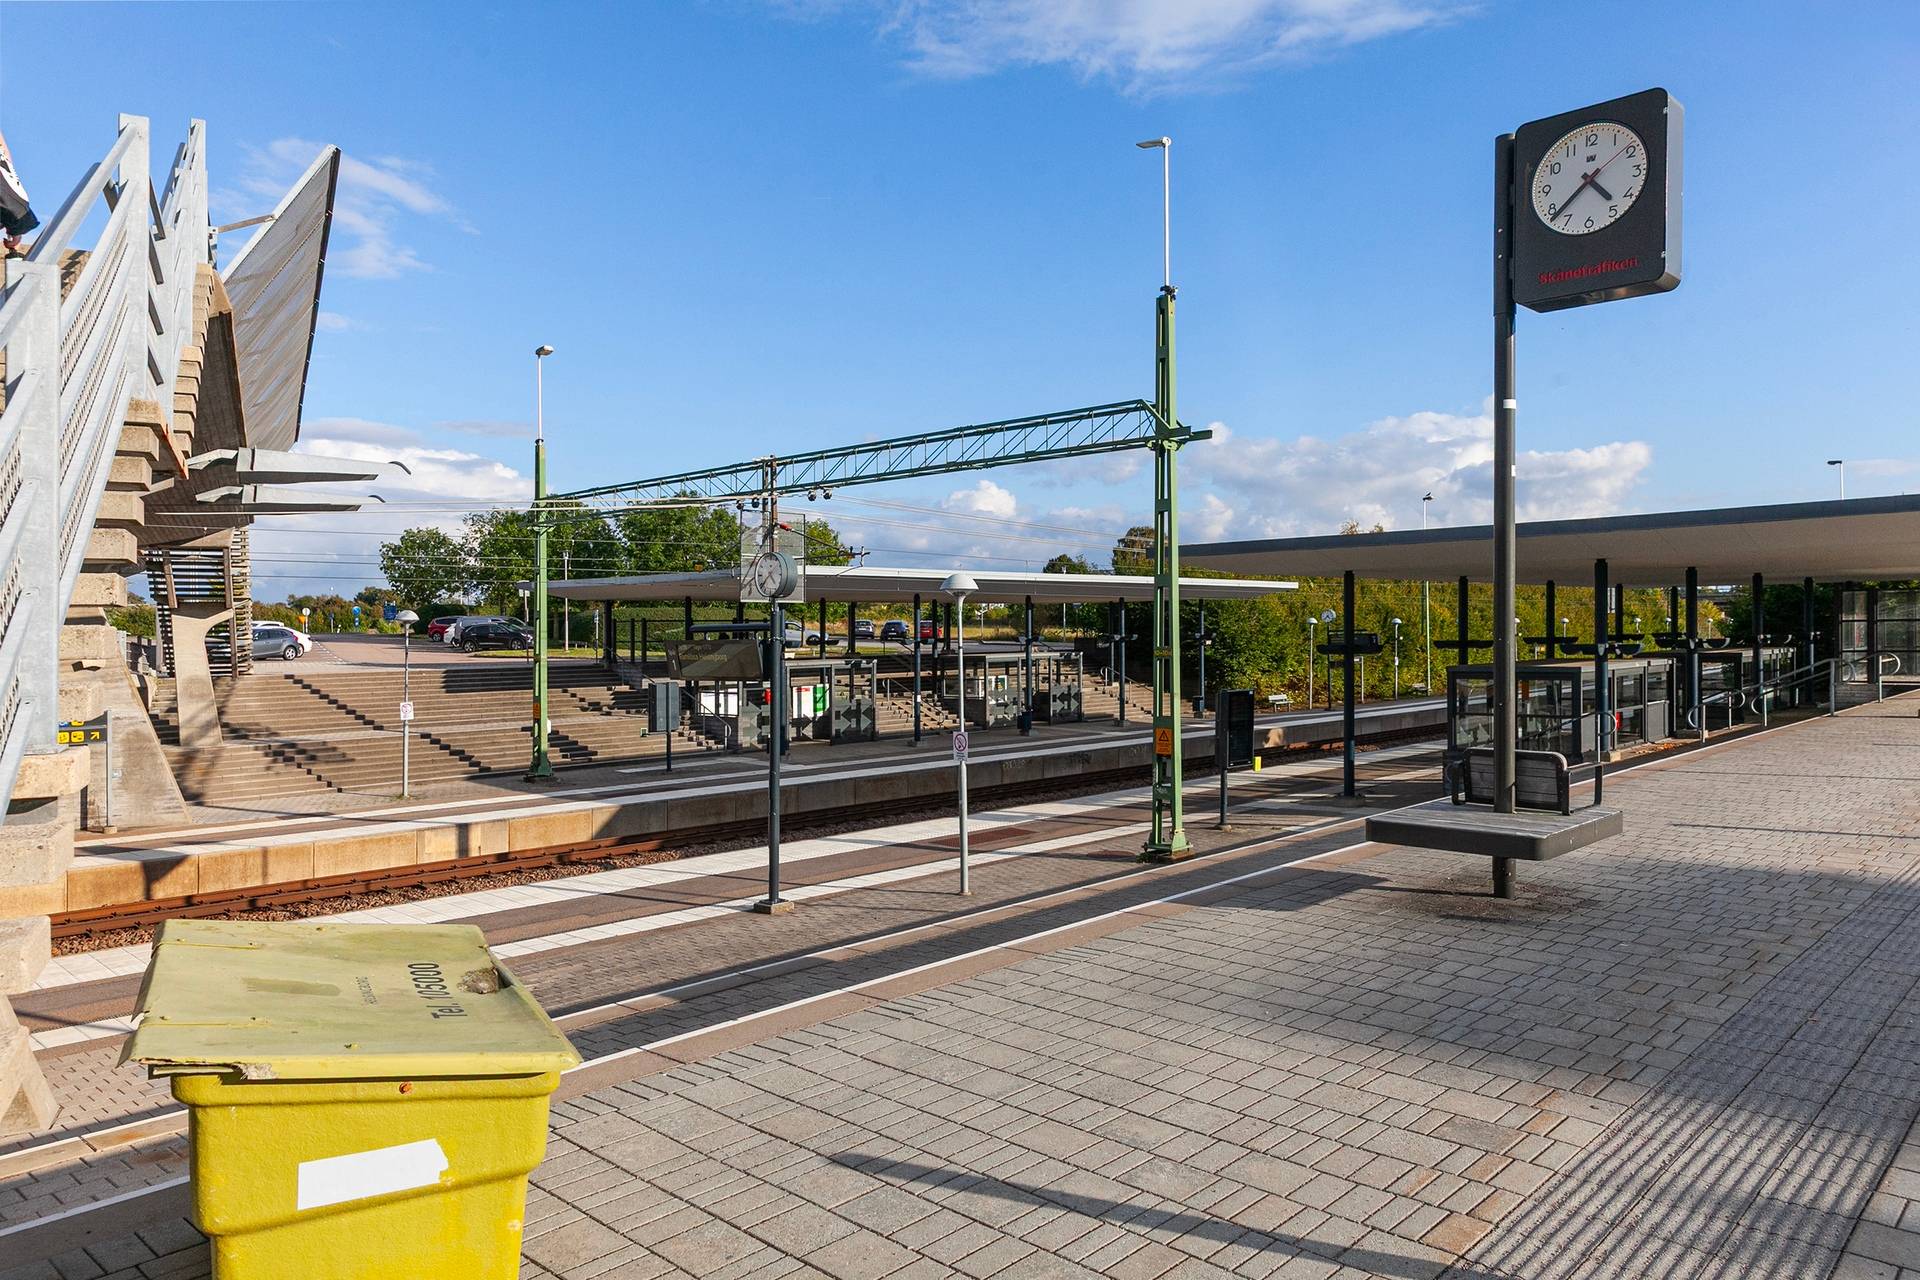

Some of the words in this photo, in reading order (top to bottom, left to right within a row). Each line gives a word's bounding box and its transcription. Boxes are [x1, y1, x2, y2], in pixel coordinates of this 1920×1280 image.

[1585, 133, 1598, 147] 12
[1566, 144, 1576, 158] 11
[1625, 145, 1636, 158] 2
[1550, 162, 1561, 175] 10
[1632, 164, 1642, 178] 3
[1542, 184, 1552, 197] 9
[1622, 186, 1634, 199] 4
[1548, 203, 1557, 216] 8
[1608, 204, 1618, 218] 5
[1564, 213, 1573, 227] 7
[1584, 216, 1594, 229] 6
[408, 963, 453, 999] 105000
[426, 1003, 467, 1018] Tel.
